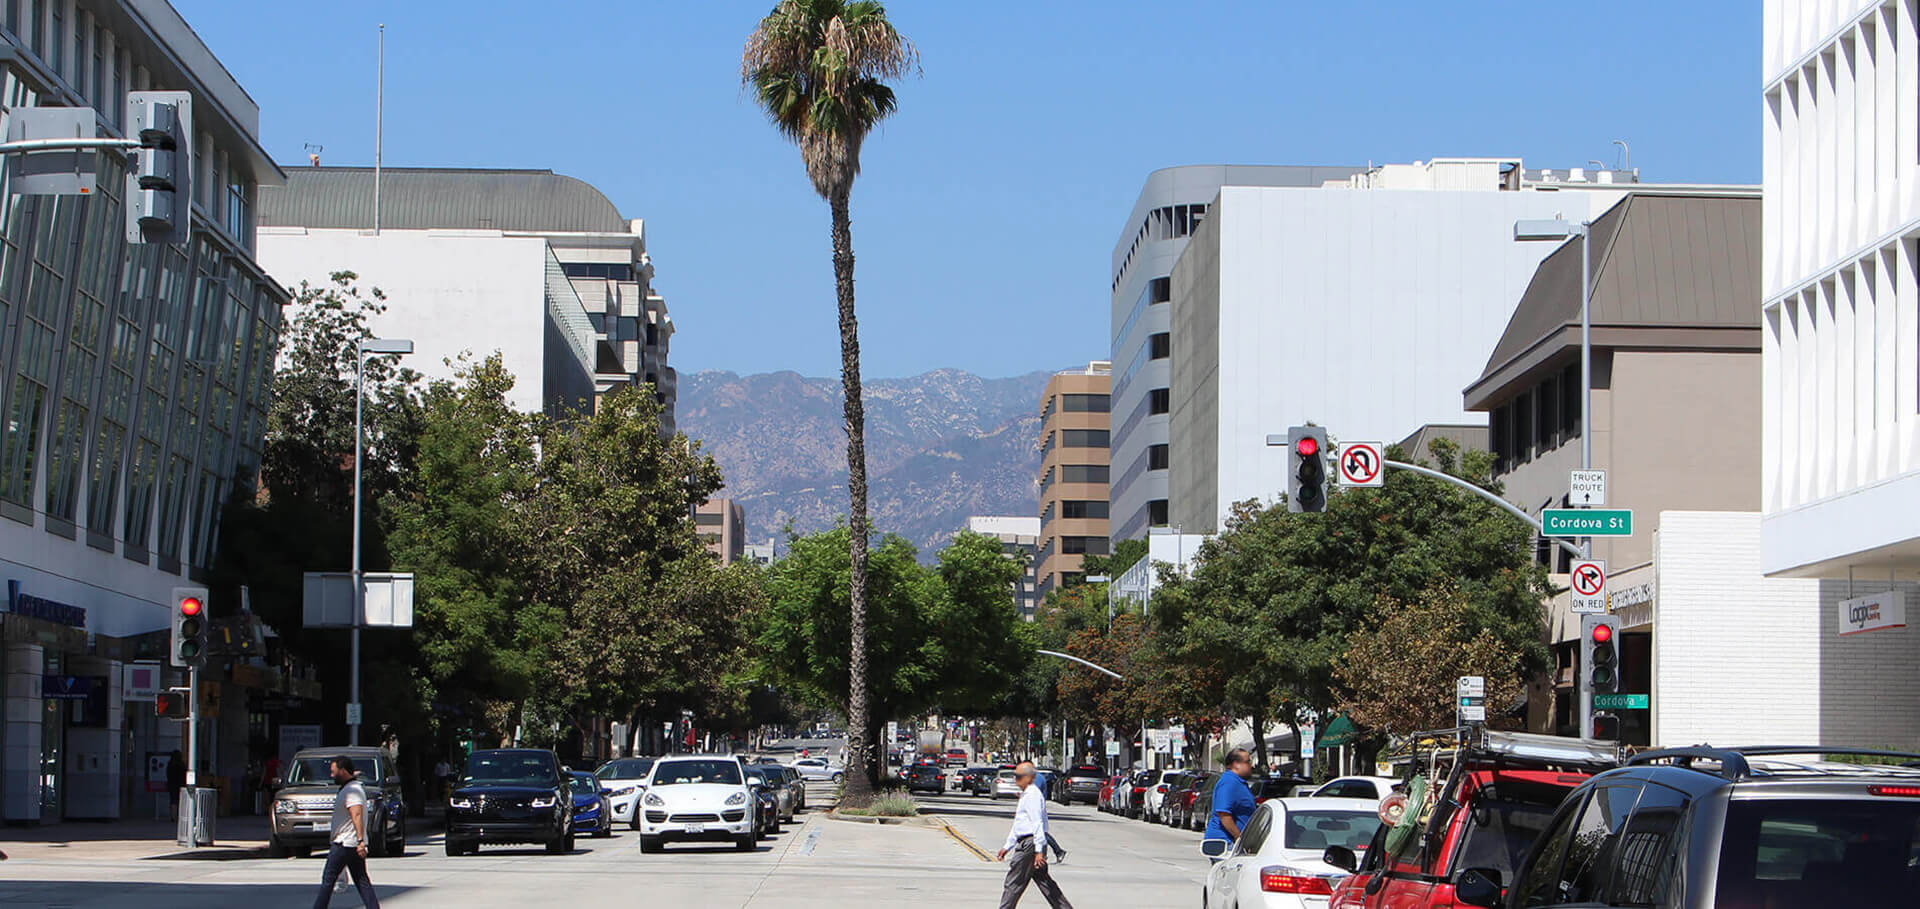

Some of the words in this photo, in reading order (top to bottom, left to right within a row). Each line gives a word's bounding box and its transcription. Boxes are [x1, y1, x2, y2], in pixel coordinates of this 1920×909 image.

[1573, 474, 1603, 482] TRUCK
[1573, 484, 1603, 492] ROUTE
[1551, 516, 1602, 529] Cordova
[1609, 517, 1624, 529] St
[1573, 599, 1584, 608] ON
[1588, 599, 1603, 608] RED
[1594, 695, 1635, 706] Cordova
